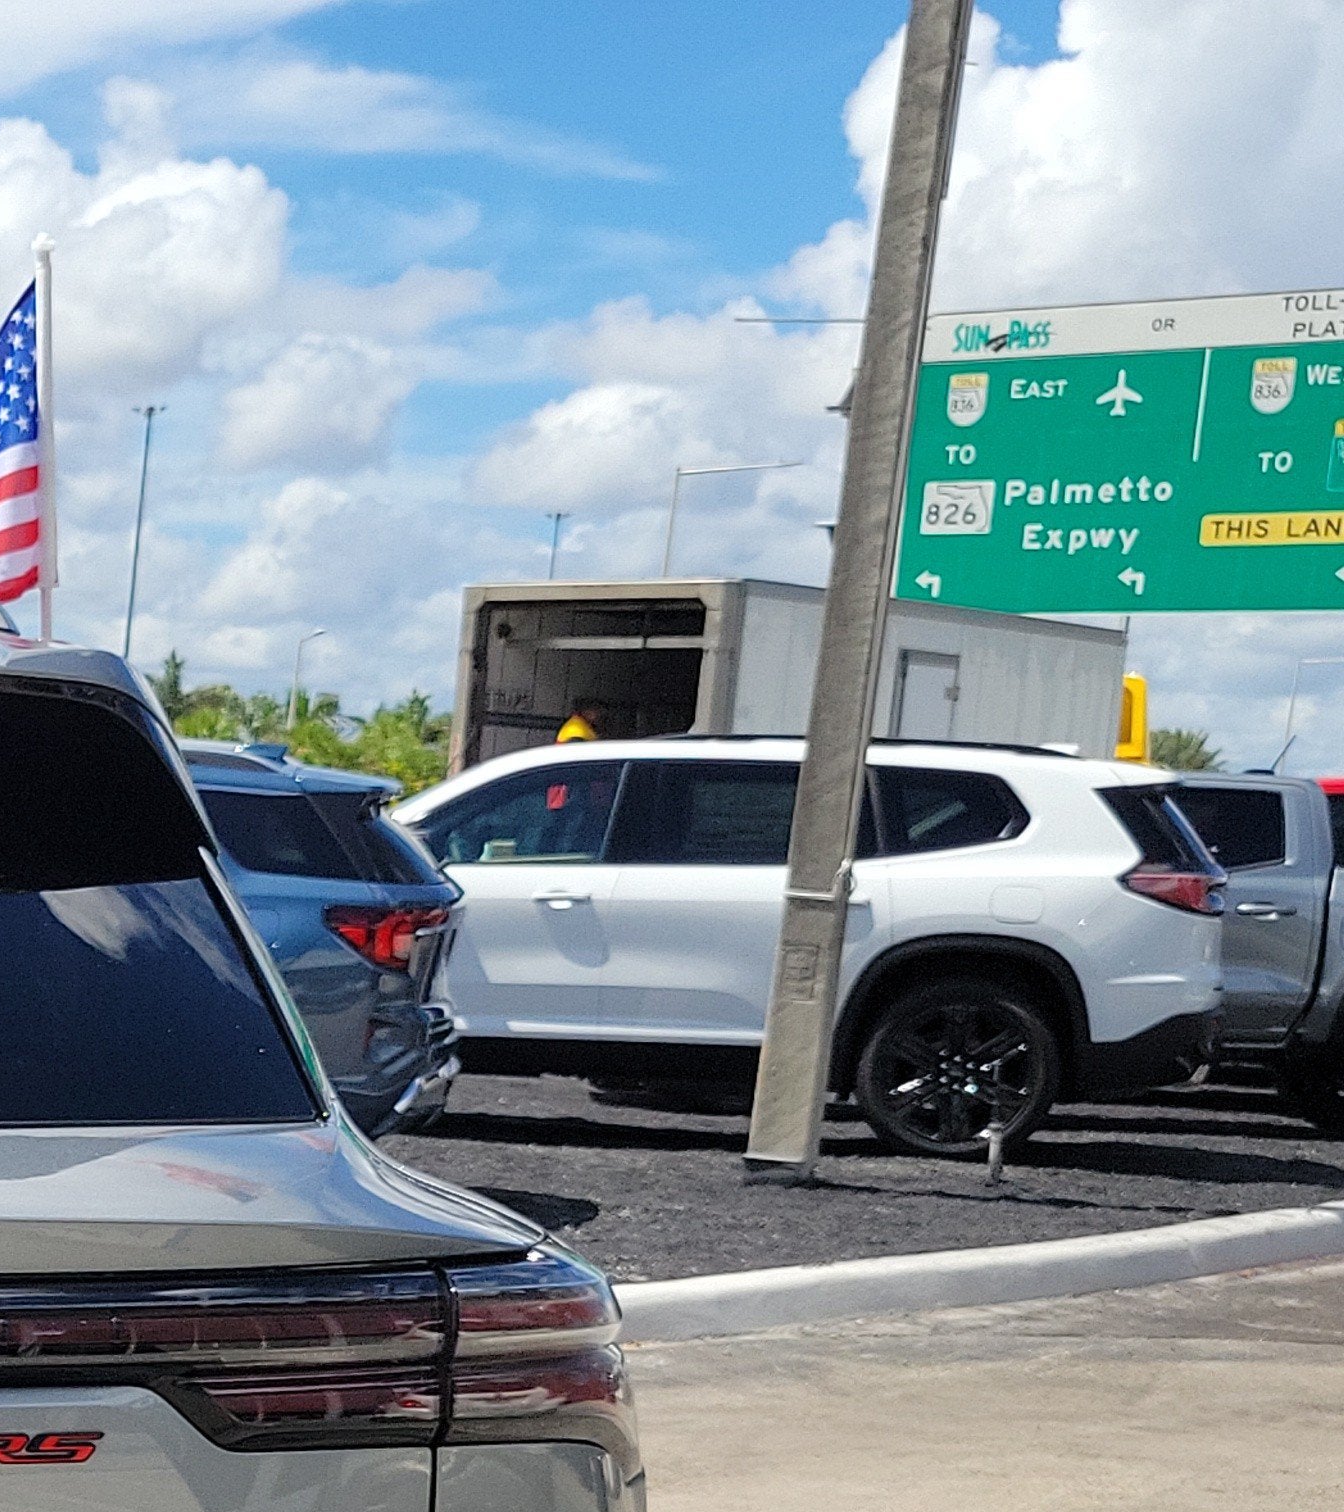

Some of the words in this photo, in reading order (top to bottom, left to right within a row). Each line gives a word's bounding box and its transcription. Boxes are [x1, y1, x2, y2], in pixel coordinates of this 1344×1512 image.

[1151, 318, 1176, 332] OR
[1306, 363, 1344, 386] WE
[1010, 378, 1069, 399] EAST
[945, 444, 977, 465] TO
[1258, 451, 1293, 473] TO
[925, 504, 977, 525] 826
[1004, 475, 1174, 506] Palmetto
[1022, 522, 1140, 555] Expwy
[1210, 519, 1269, 539] THIS
